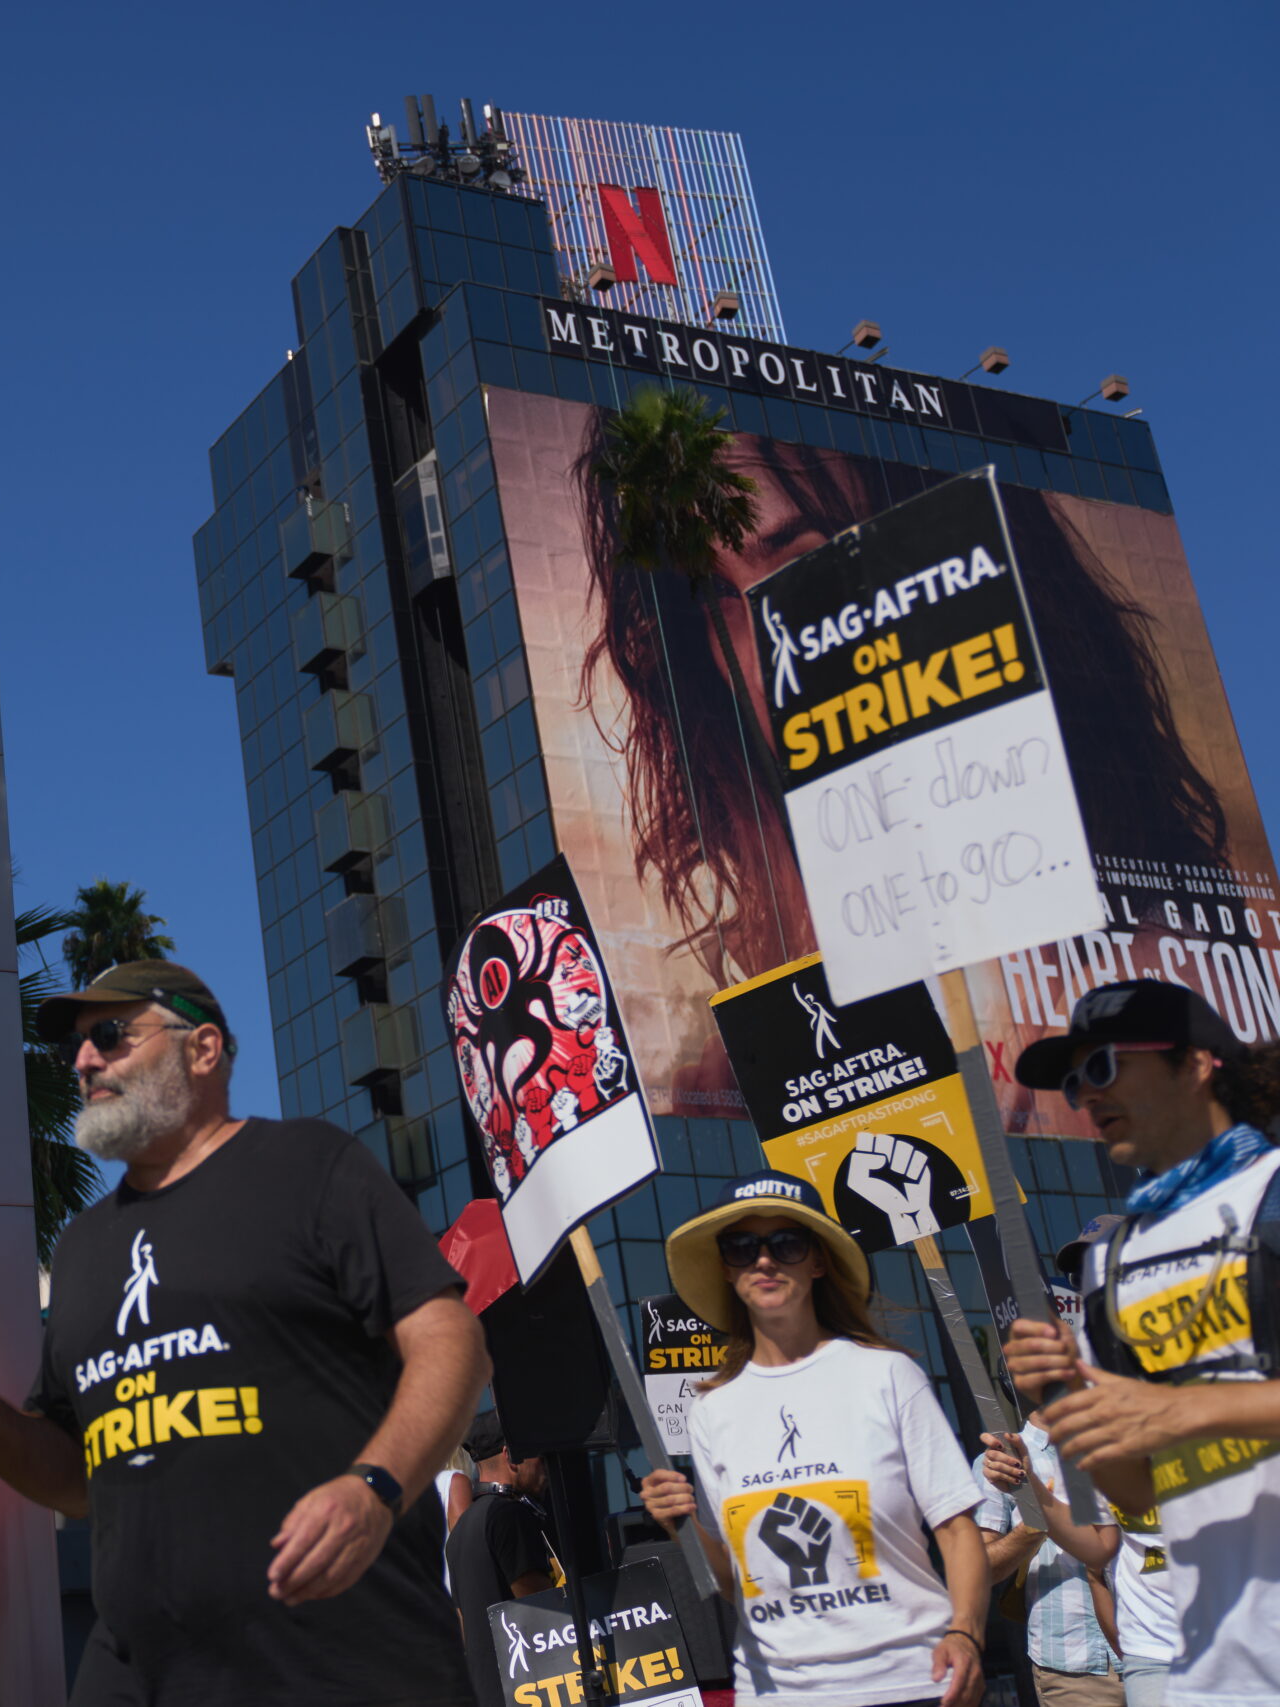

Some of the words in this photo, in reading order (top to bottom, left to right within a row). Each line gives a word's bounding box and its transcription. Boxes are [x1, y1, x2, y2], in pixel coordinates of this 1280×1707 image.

[597, 184, 678, 287] N
[545, 307, 944, 420] METROPOLITAN
[853, 633, 902, 676] ON
[782, 622, 1026, 772] STRIKE!
[841, 872, 918, 938] ONE
[1106, 870, 1173, 892] IMPOSSIBLE
[1185, 879, 1214, 895] DEAD
[998, 930, 1139, 1028] HEART
[1158, 935, 1280, 1044] STON
[782, 1095, 822, 1123] ON
[824, 1055, 928, 1110] STRIKE!
[795, 1088, 937, 1148] #SAGAFTRASTRONG
[734, 1180, 802, 1200] EQUITY!
[690, 1333, 712, 1346] ON
[115, 1371, 156, 1402] ON
[658, 1403, 683, 1414] CAN
[750, 1600, 786, 1624] ON
[789, 1583, 892, 1615] STRIKE!
